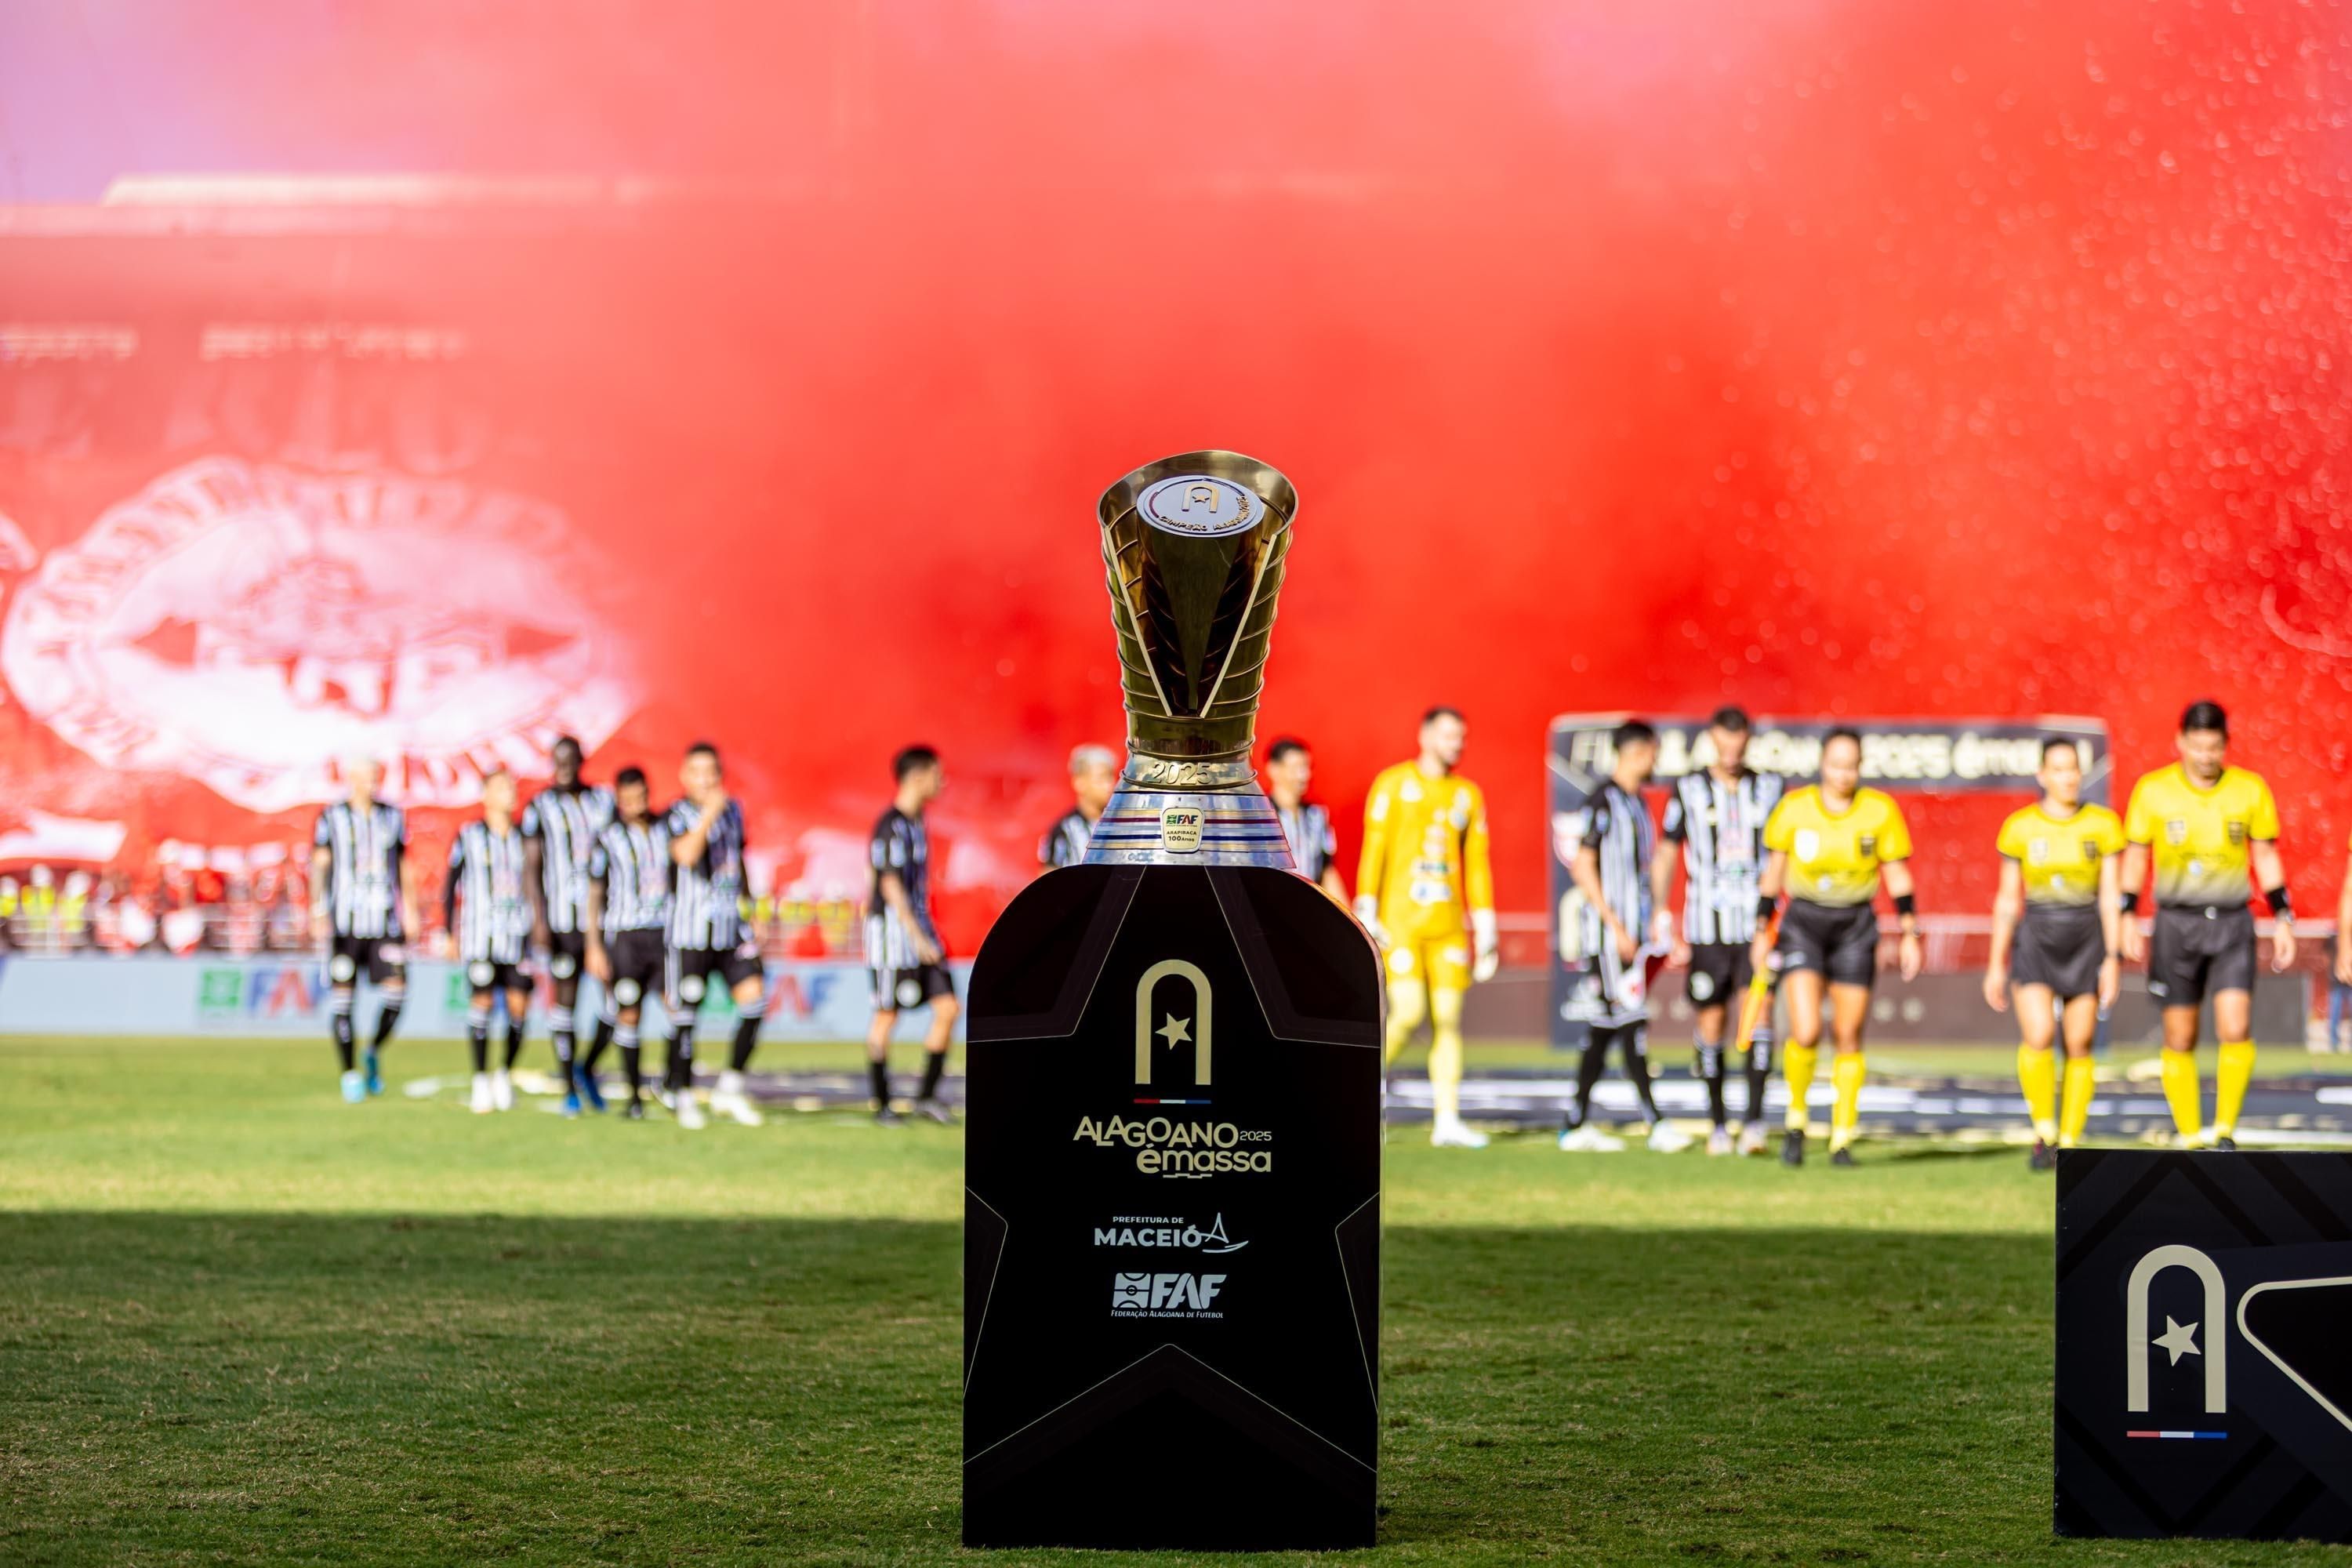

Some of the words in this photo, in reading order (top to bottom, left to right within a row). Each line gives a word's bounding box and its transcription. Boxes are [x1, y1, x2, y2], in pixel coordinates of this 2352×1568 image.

[1148, 761, 1212, 785] 2025
[1177, 815, 1199, 824] FAF
[1073, 1115, 1238, 1148] ALAGOANO
[1240, 1131, 1272, 1142] 2025
[1094, 1225, 1202, 1247] MACEIÓ
[1150, 1273, 1227, 1309] FAF
